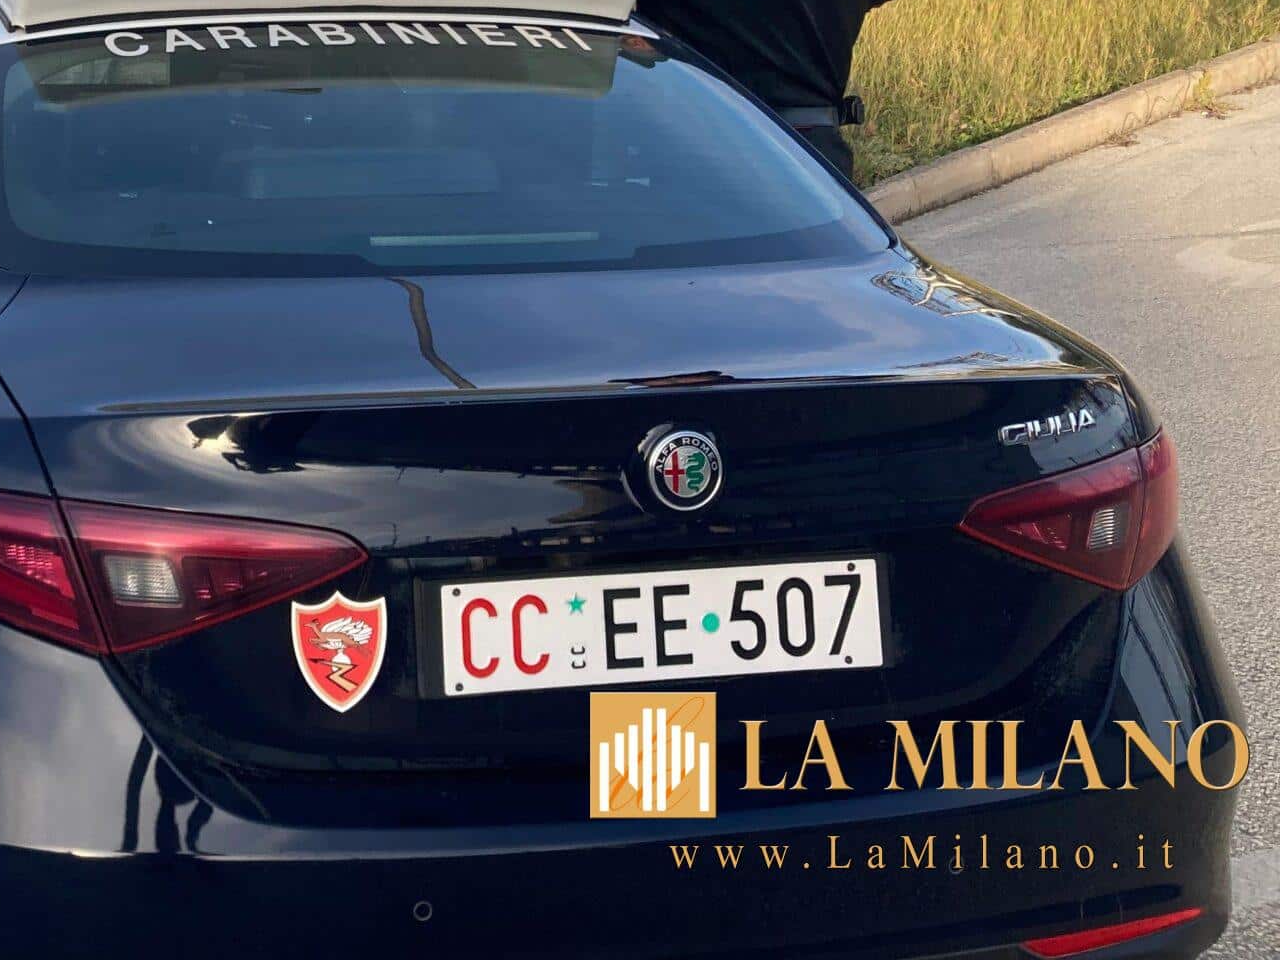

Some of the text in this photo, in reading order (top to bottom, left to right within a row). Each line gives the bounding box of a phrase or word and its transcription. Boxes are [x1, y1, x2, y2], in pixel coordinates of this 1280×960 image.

[104, 22, 593, 57] CARABINIERI
[998, 408, 1097, 446] GIULIA
[655, 437, 719, 474] ALFA ROMEO
[460, 573, 862, 679] CC EE 507
